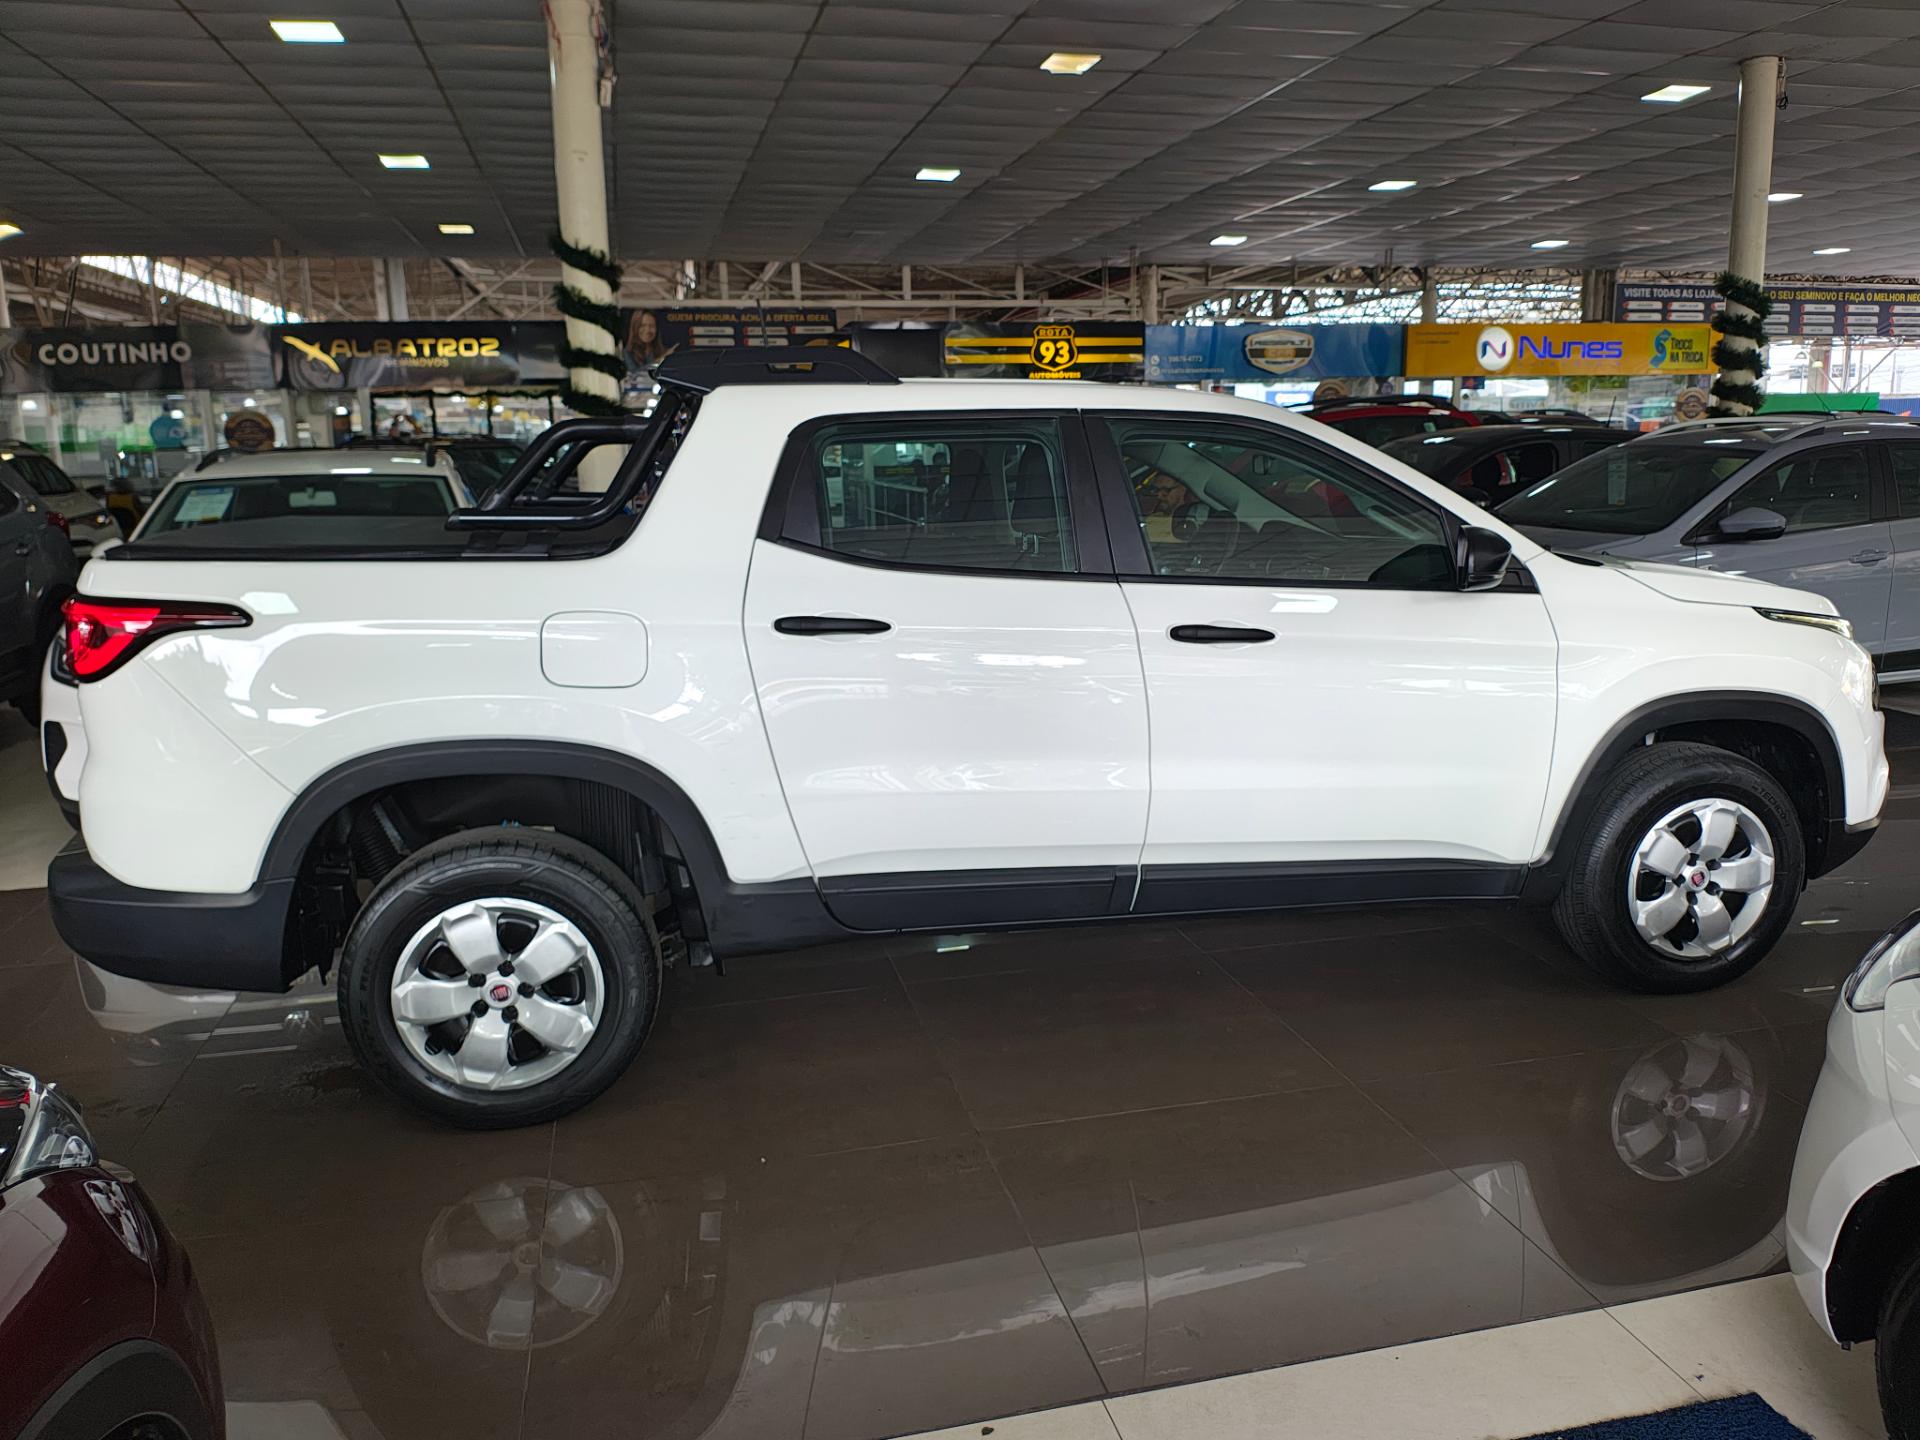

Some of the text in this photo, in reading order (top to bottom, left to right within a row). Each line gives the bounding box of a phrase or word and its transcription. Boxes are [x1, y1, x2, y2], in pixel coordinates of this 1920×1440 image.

[1624, 287, 1651, 298] VISITE
[1653, 287, 1680, 298] TODAS
[1682, 289, 1693, 298] AS
[1770, 291, 1776, 300] O
[1778, 291, 1794, 300] SEU
[1796, 291, 1837, 301] SEMINOVO
[1839, 293, 1845, 301] E
[1846, 293, 1865, 303] FAÇA
[1866, 292, 1873, 302] O
[1874, 292, 1906, 302] MELHOR
[1039, 329, 1069, 337] ROTA
[38, 341, 192, 365] COUTINHO
[330, 338, 500, 358] ALBATROZ
[1040, 341, 1070, 364] 93
[1518, 335, 1623, 359] Nunes
[1029, 371, 1081, 379] AUTOMÓVEIS
